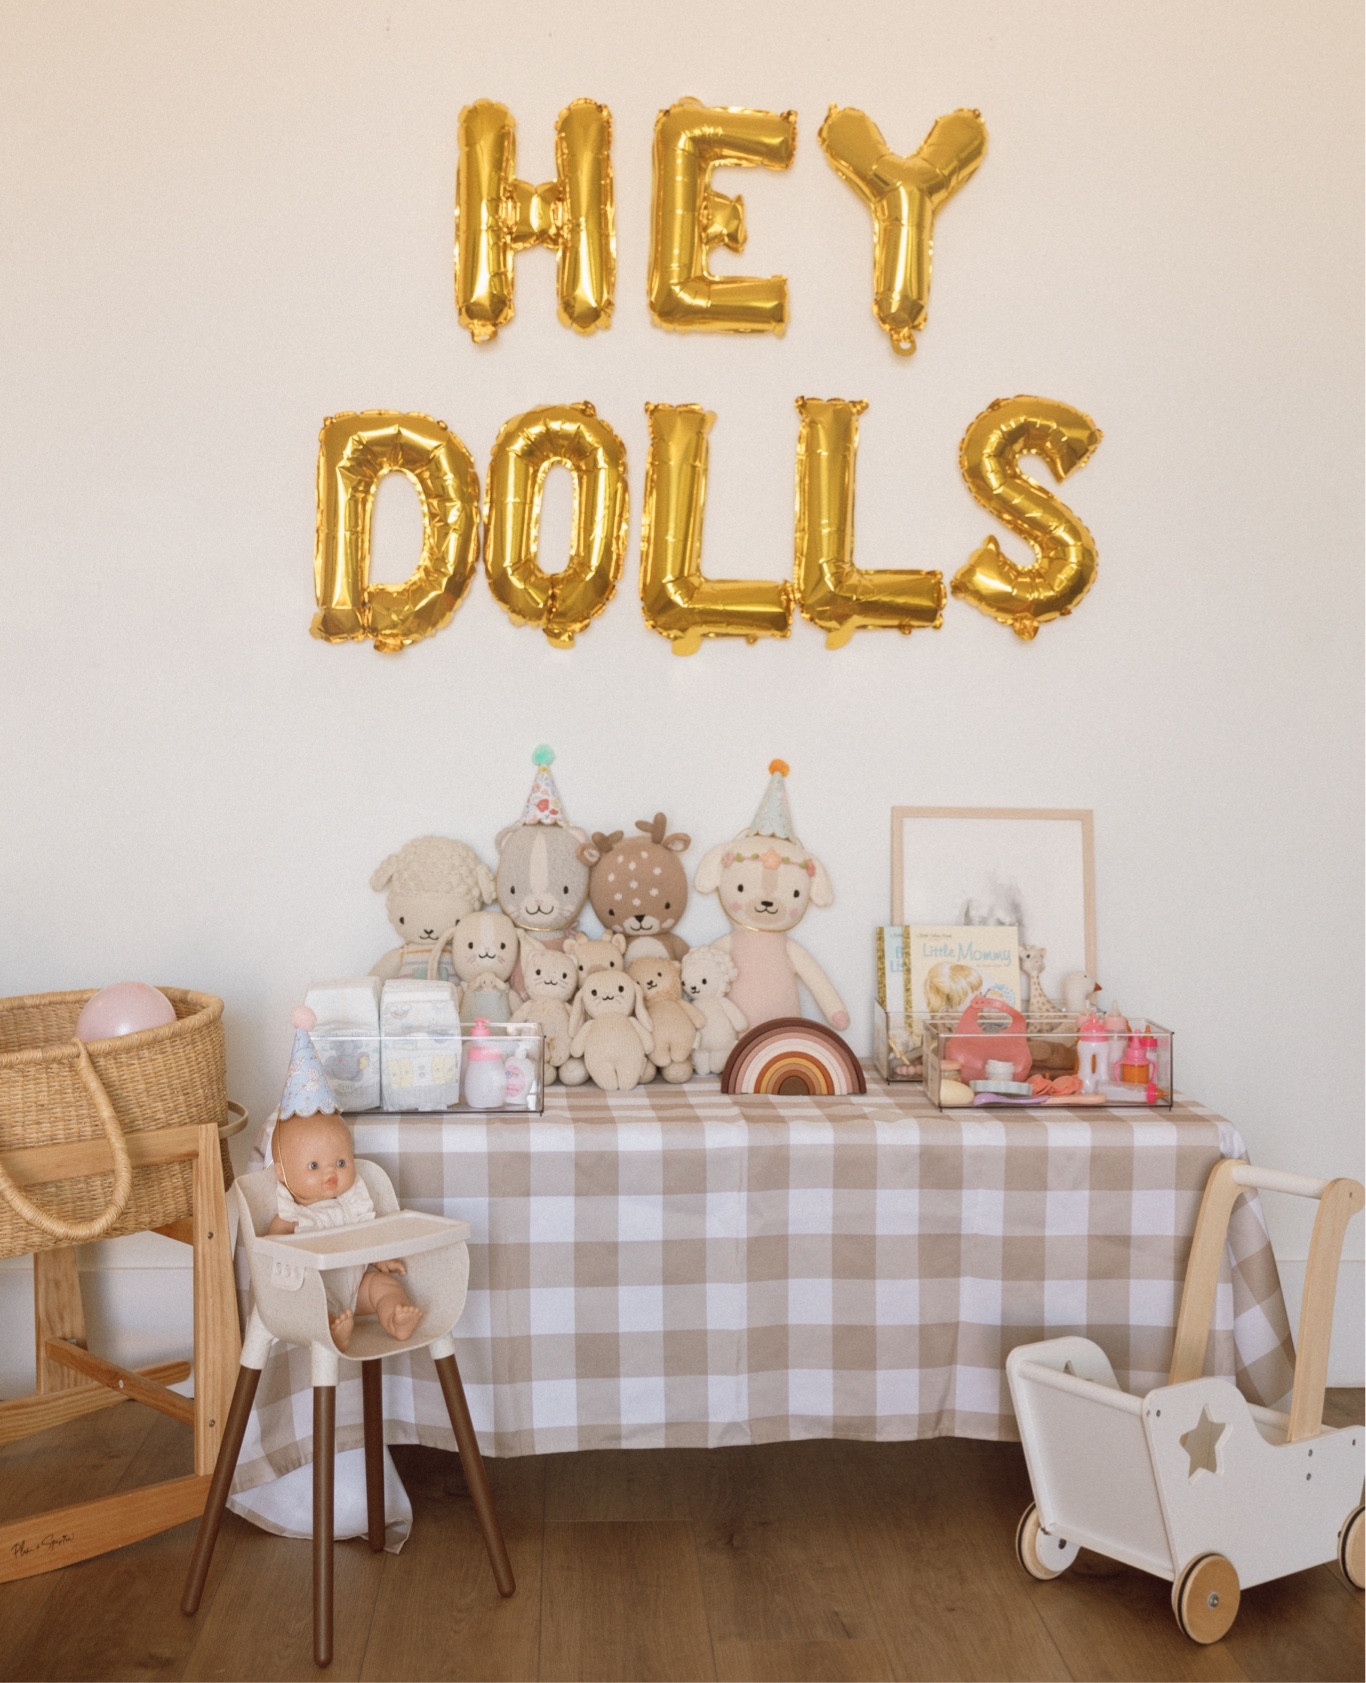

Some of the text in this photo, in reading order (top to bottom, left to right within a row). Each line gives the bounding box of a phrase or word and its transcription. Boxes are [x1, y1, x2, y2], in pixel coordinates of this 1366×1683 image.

[454, 97, 989, 357] HEY
[310, 395, 1104, 655] DOLLS
[922, 942, 956, 959] Little
[956, 941, 1012, 967] Mommy
